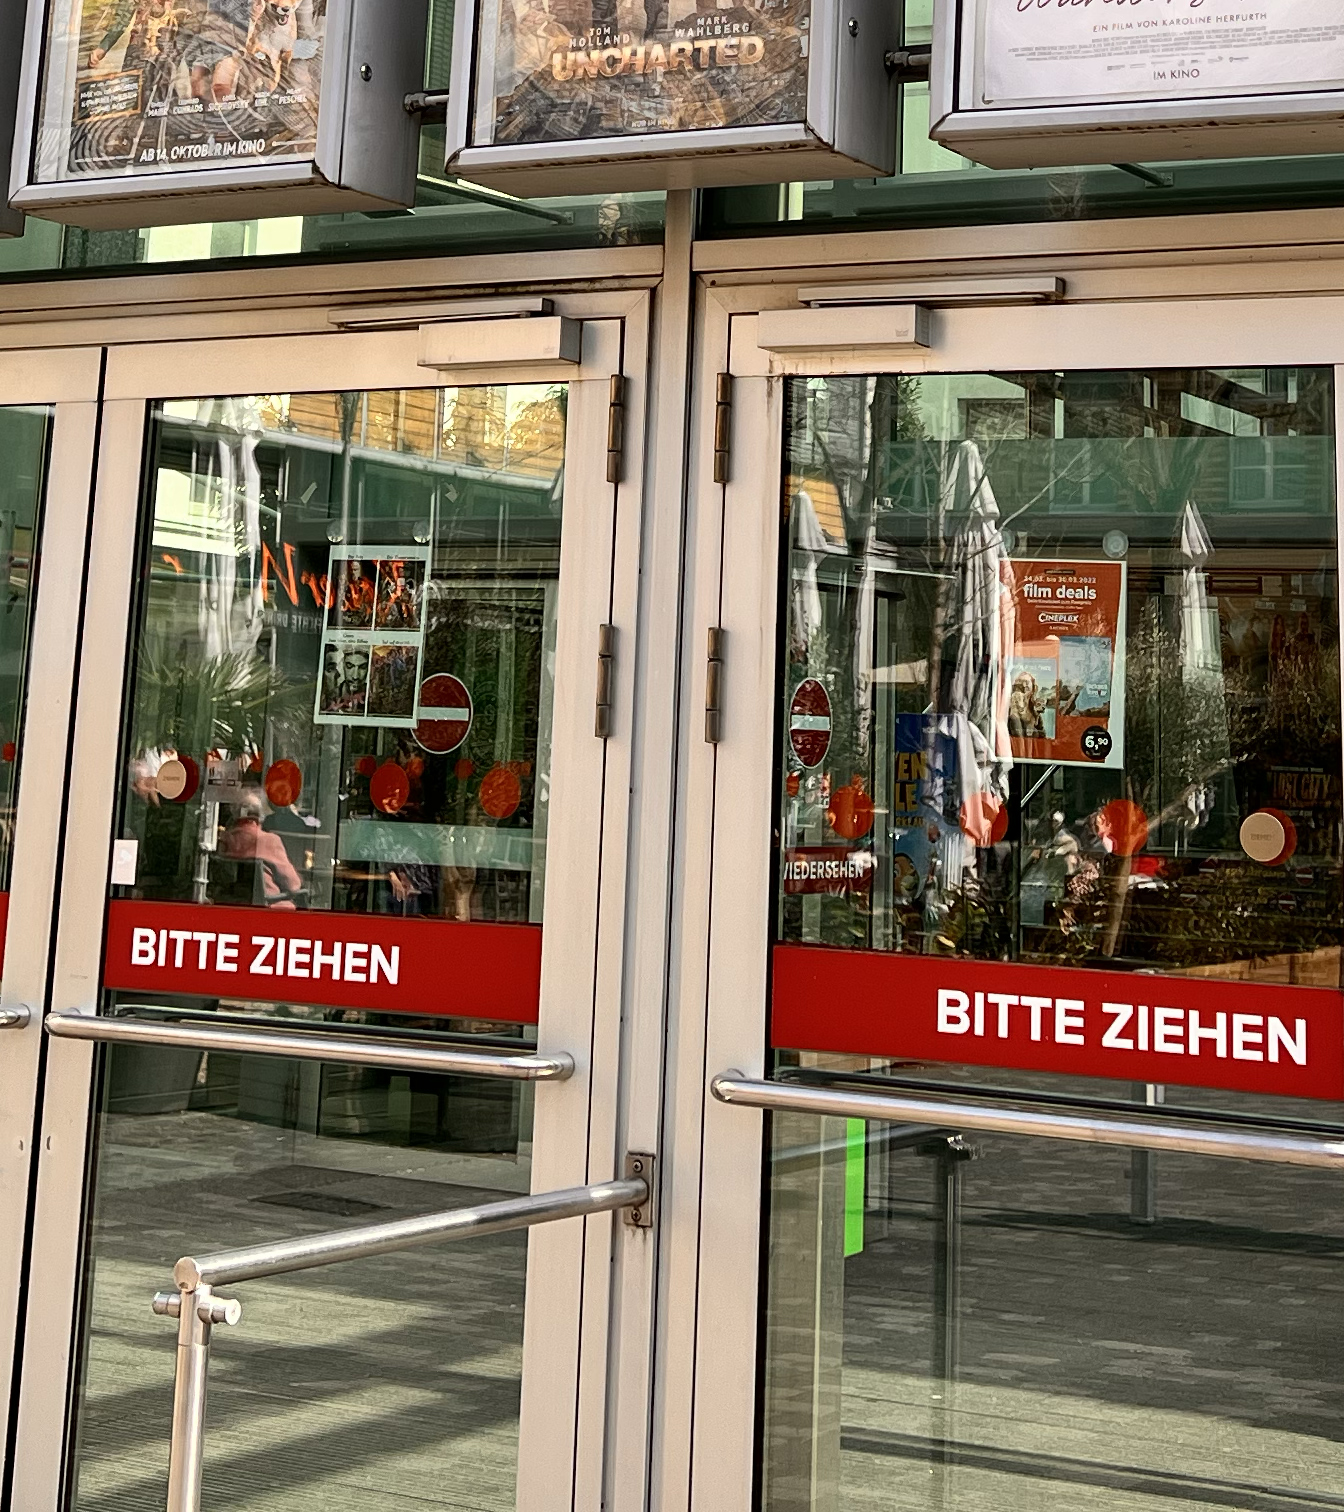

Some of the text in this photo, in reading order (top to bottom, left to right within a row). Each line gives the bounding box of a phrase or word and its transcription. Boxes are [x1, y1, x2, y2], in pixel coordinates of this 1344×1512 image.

[697, 15, 728, 26] MARK
[1112, 21, 1134, 32] FILM
[1137, 19, 1159, 30] VON
[1161, 15, 1212, 28] KAROLINE
[1215, 12, 1268, 24] HERFURTH
[589, 26, 611, 37] TOM
[675, 22, 750, 39] WAHLBERG
[569, 33, 630, 48] HOLLAND
[552, 36, 765, 81] UNCHARTED
[1152, 68, 1200, 81] IM KINO
[140, 148, 155, 162] AB
[238, 138, 266, 155] KINO
[1022, 582, 1097, 600] film deals
[131, 925, 400, 986] BITTE ZIEHEN
[936, 988, 1308, 1066] BITTE ZIEHEN
